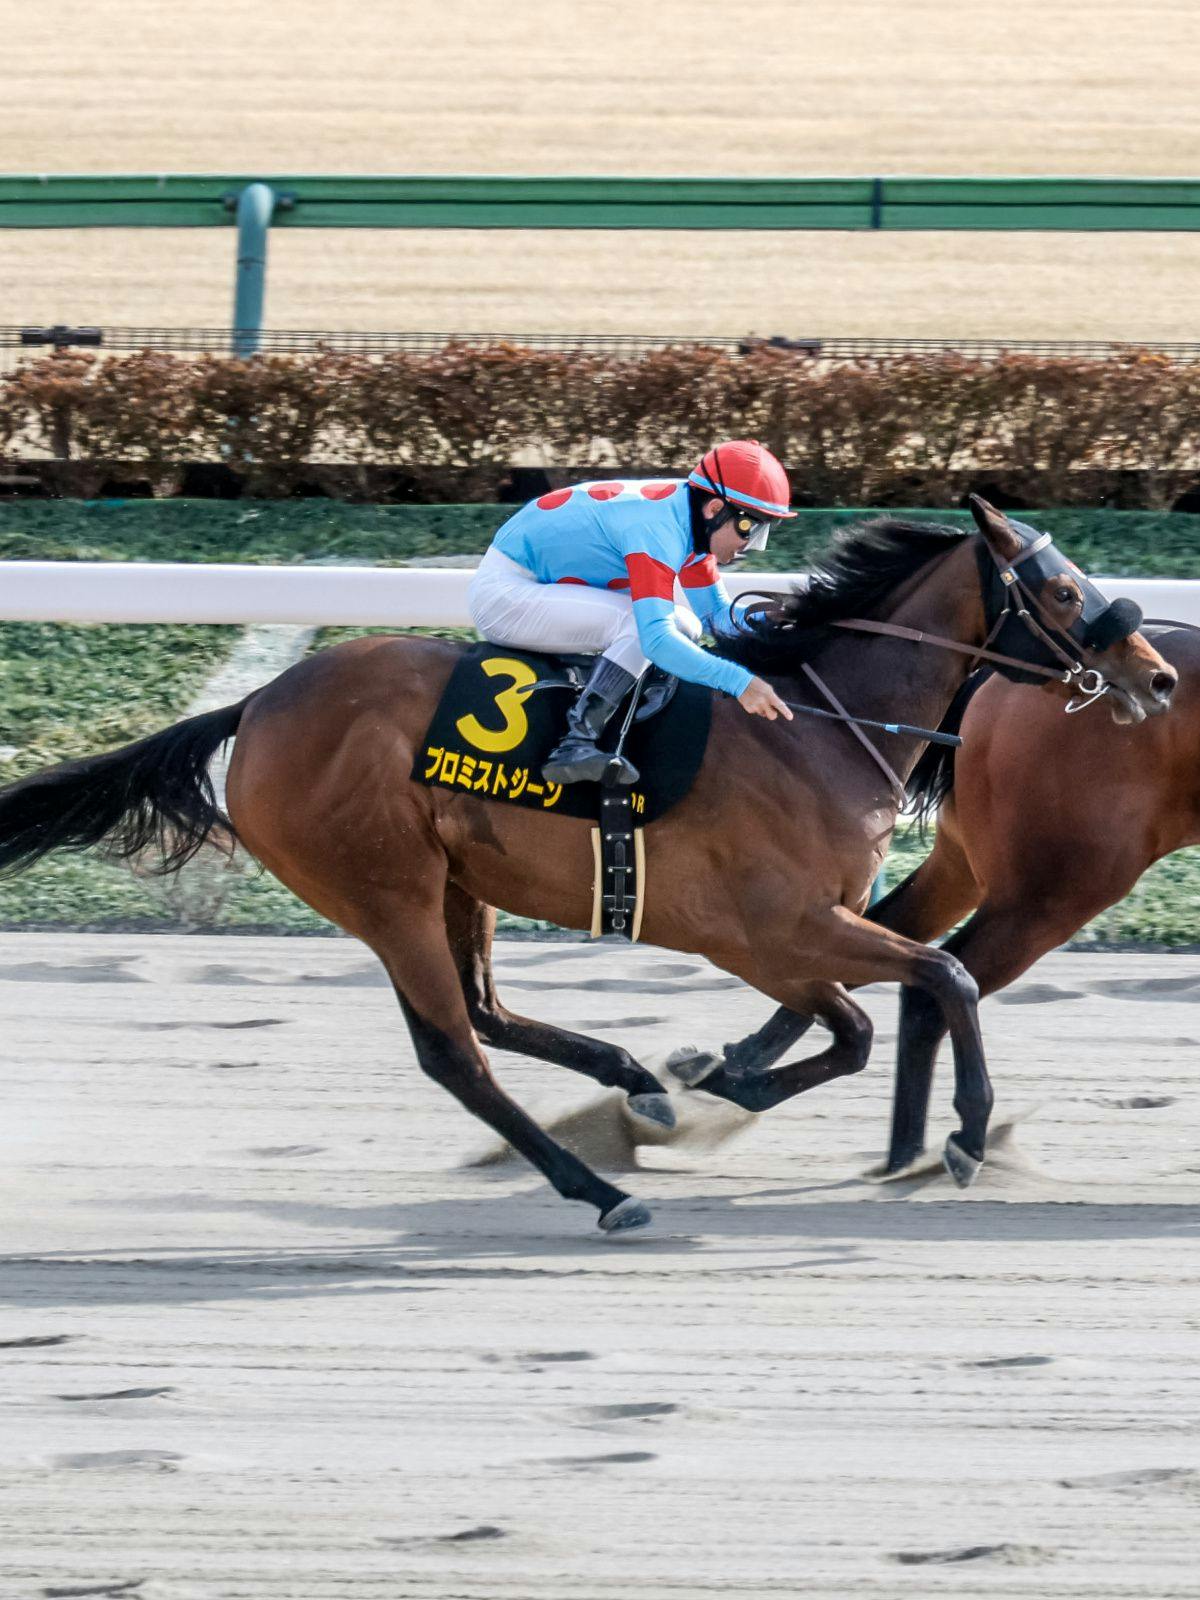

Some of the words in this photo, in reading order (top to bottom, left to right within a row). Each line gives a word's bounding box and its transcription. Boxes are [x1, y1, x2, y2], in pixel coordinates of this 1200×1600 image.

[456, 657, 537, 752] 3
[425, 747, 563, 807] プロミストジーン
